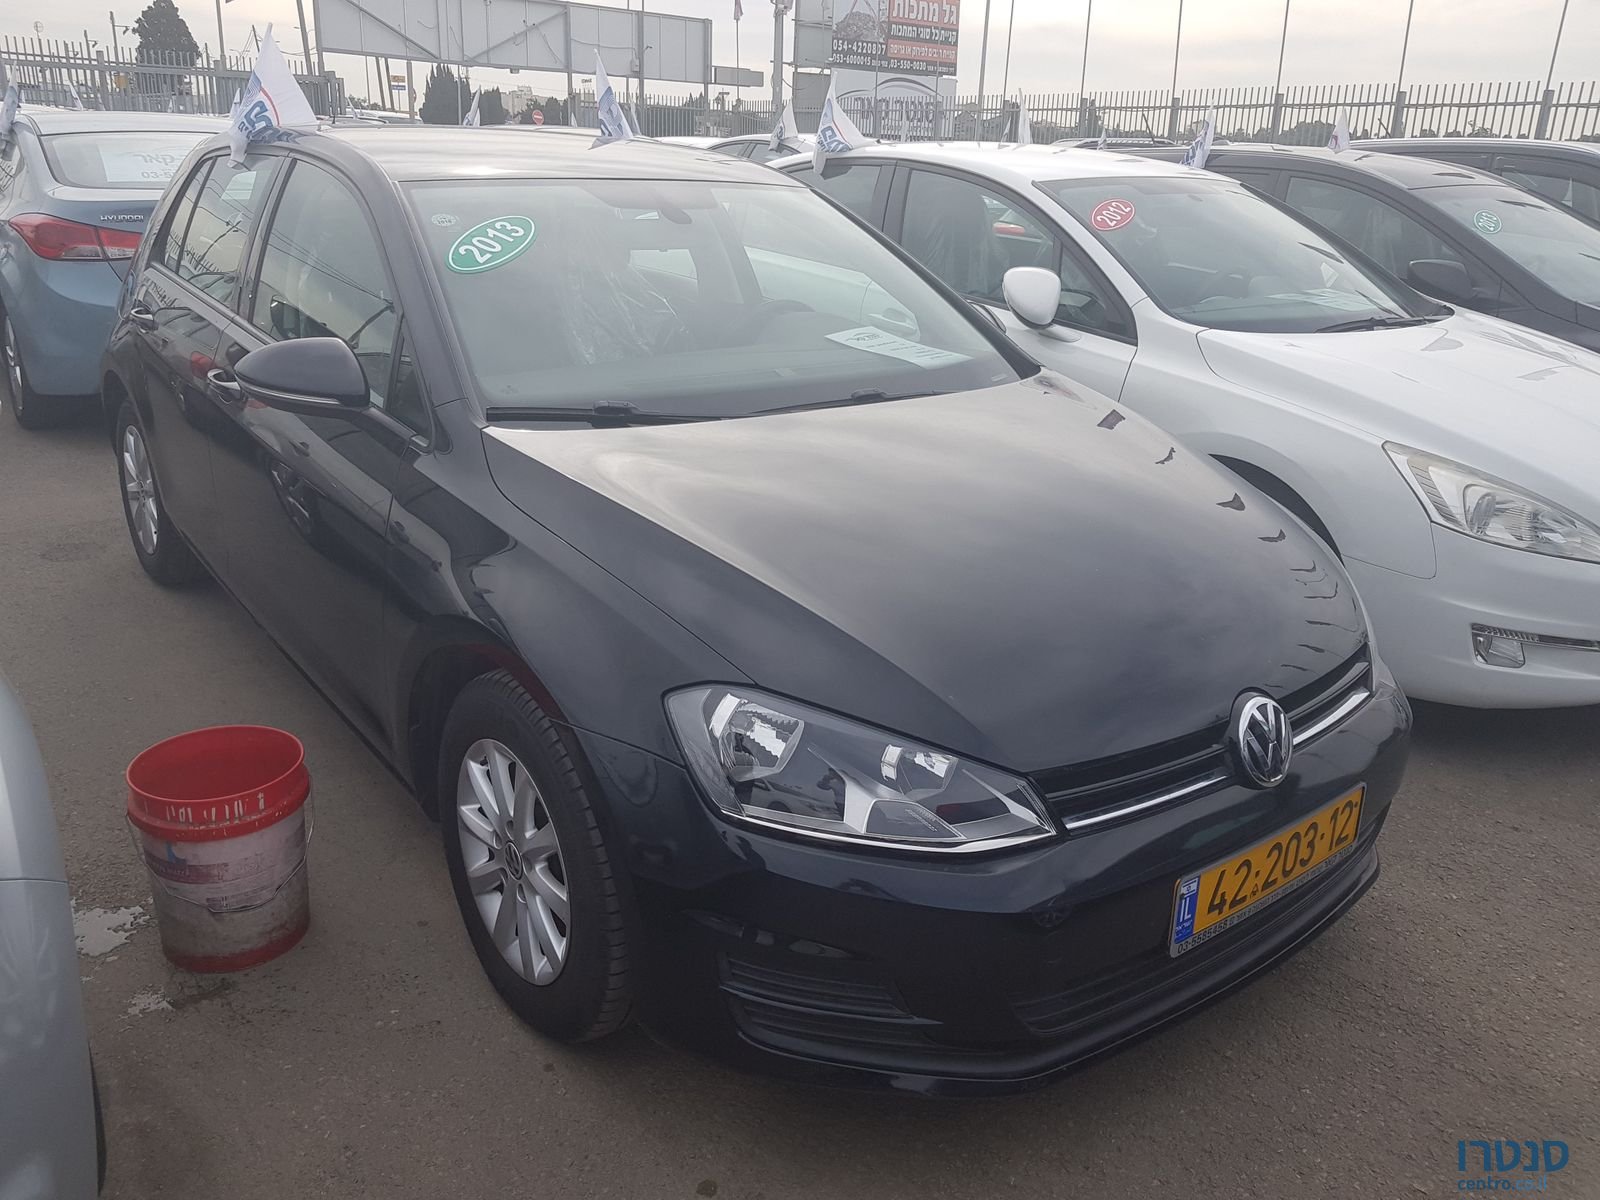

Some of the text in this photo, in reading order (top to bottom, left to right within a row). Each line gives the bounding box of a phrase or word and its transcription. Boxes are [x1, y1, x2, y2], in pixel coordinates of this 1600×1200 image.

[892, 0, 957, 25] גל מתכות
[891, 24, 917, 39] המתכות
[100, 214, 144, 223] HYUNDAI
[1096, 201, 1132, 227] 2012
[458, 221, 525, 264] 2013
[1180, 896, 1192, 923] IL
